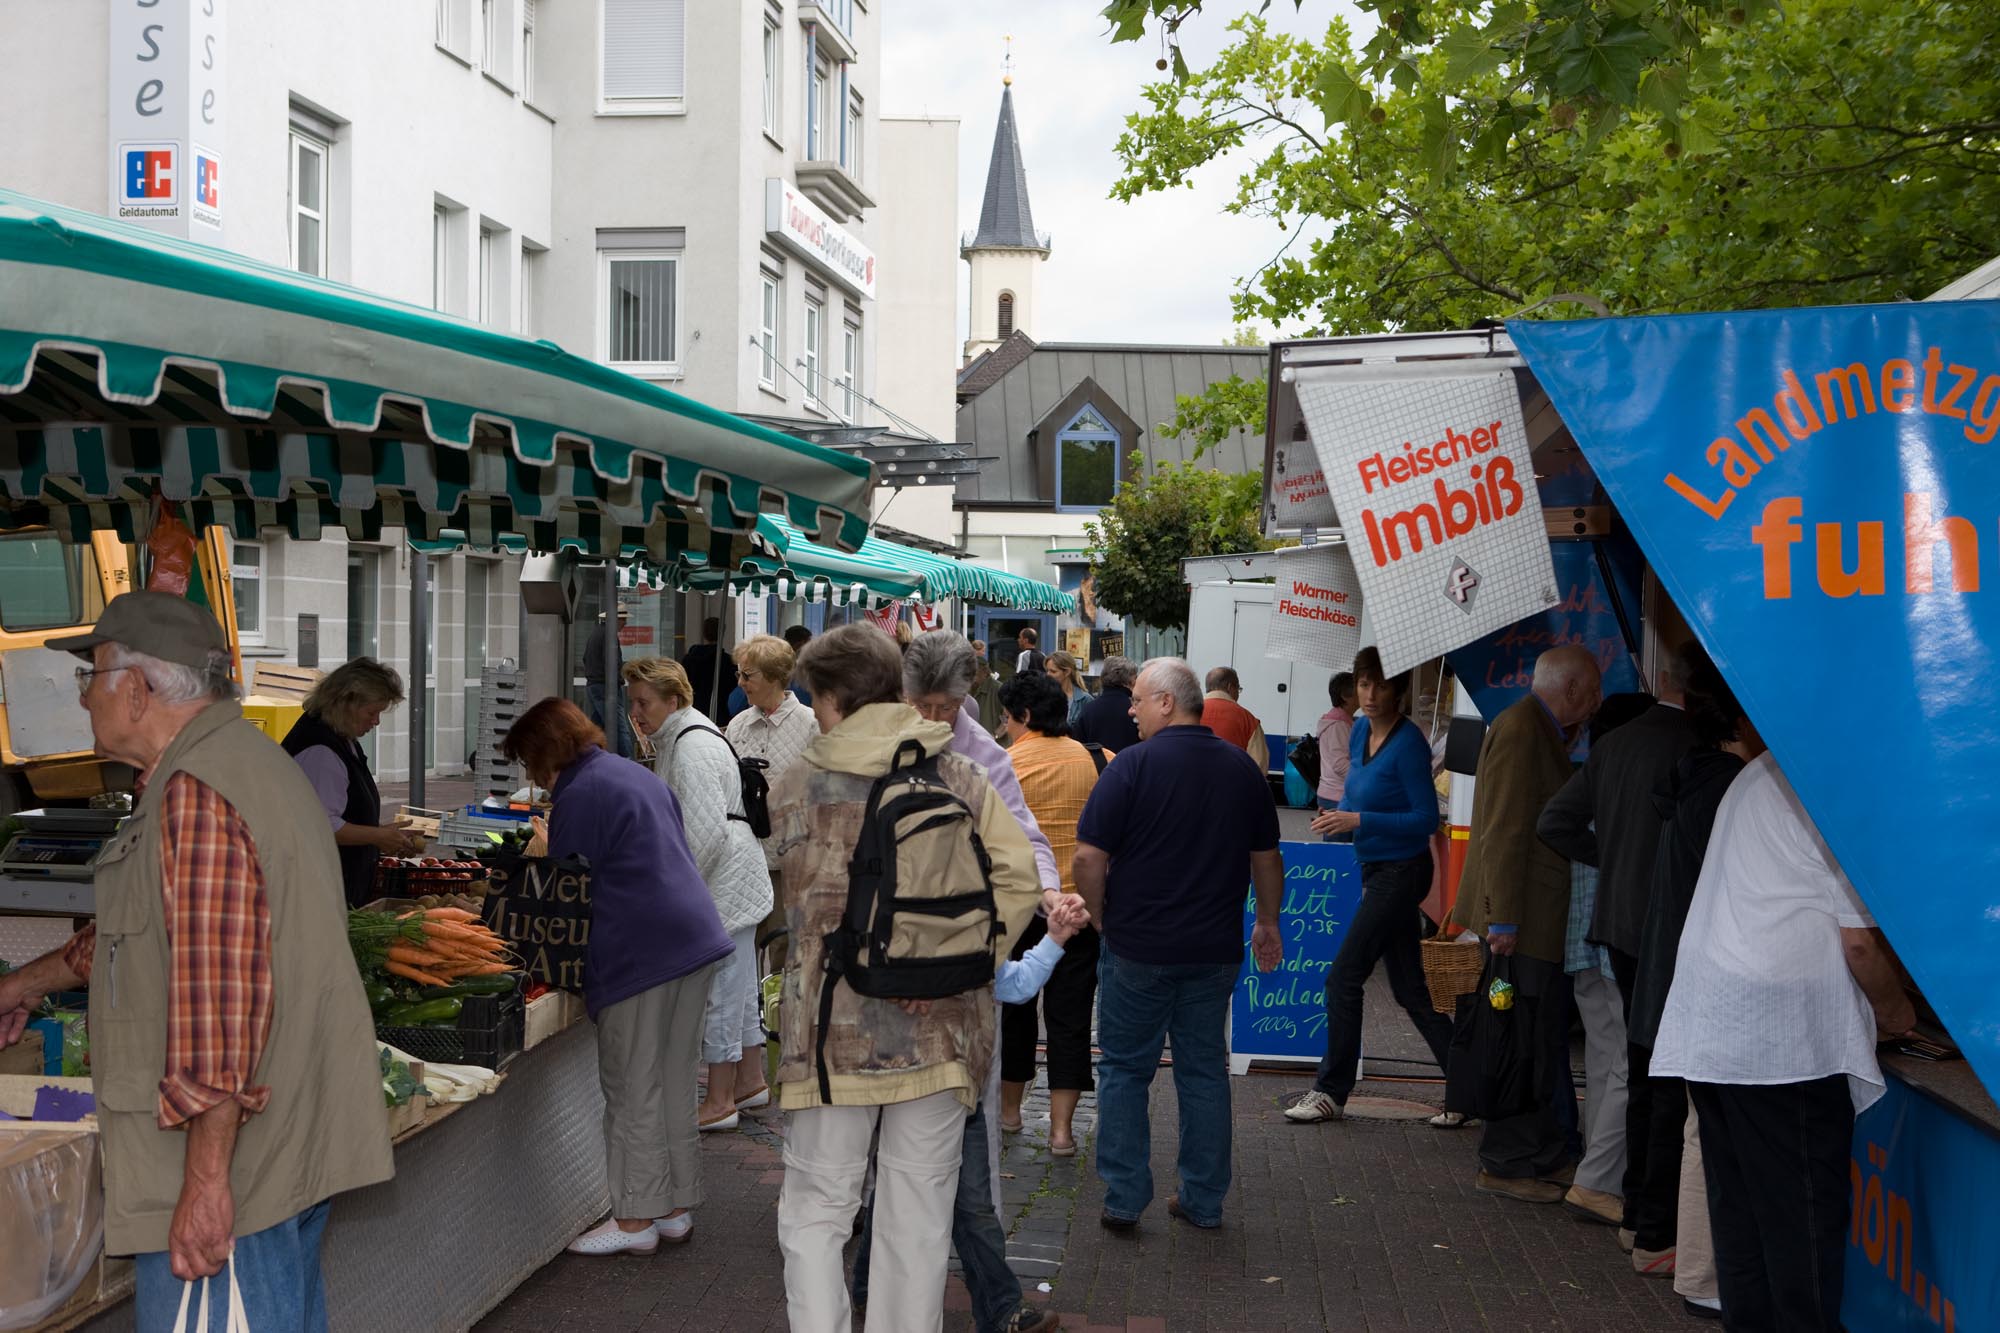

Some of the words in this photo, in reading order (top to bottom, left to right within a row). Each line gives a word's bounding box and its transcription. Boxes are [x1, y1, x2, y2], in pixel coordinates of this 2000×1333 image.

[119, 207, 179, 217] Geldautomat
[1357, 420, 1502, 495] Fleischer
[1361, 456, 1523, 568] Imbiß
[1751, 491, 2000, 600] fuh
[1279, 599, 1356, 627] Fleischkäse
[1293, 580, 1349, 604] Warmer
[518, 862, 592, 904] Met
[526, 946, 585, 988] Art
[1243, 975, 1328, 1012] Roulad
